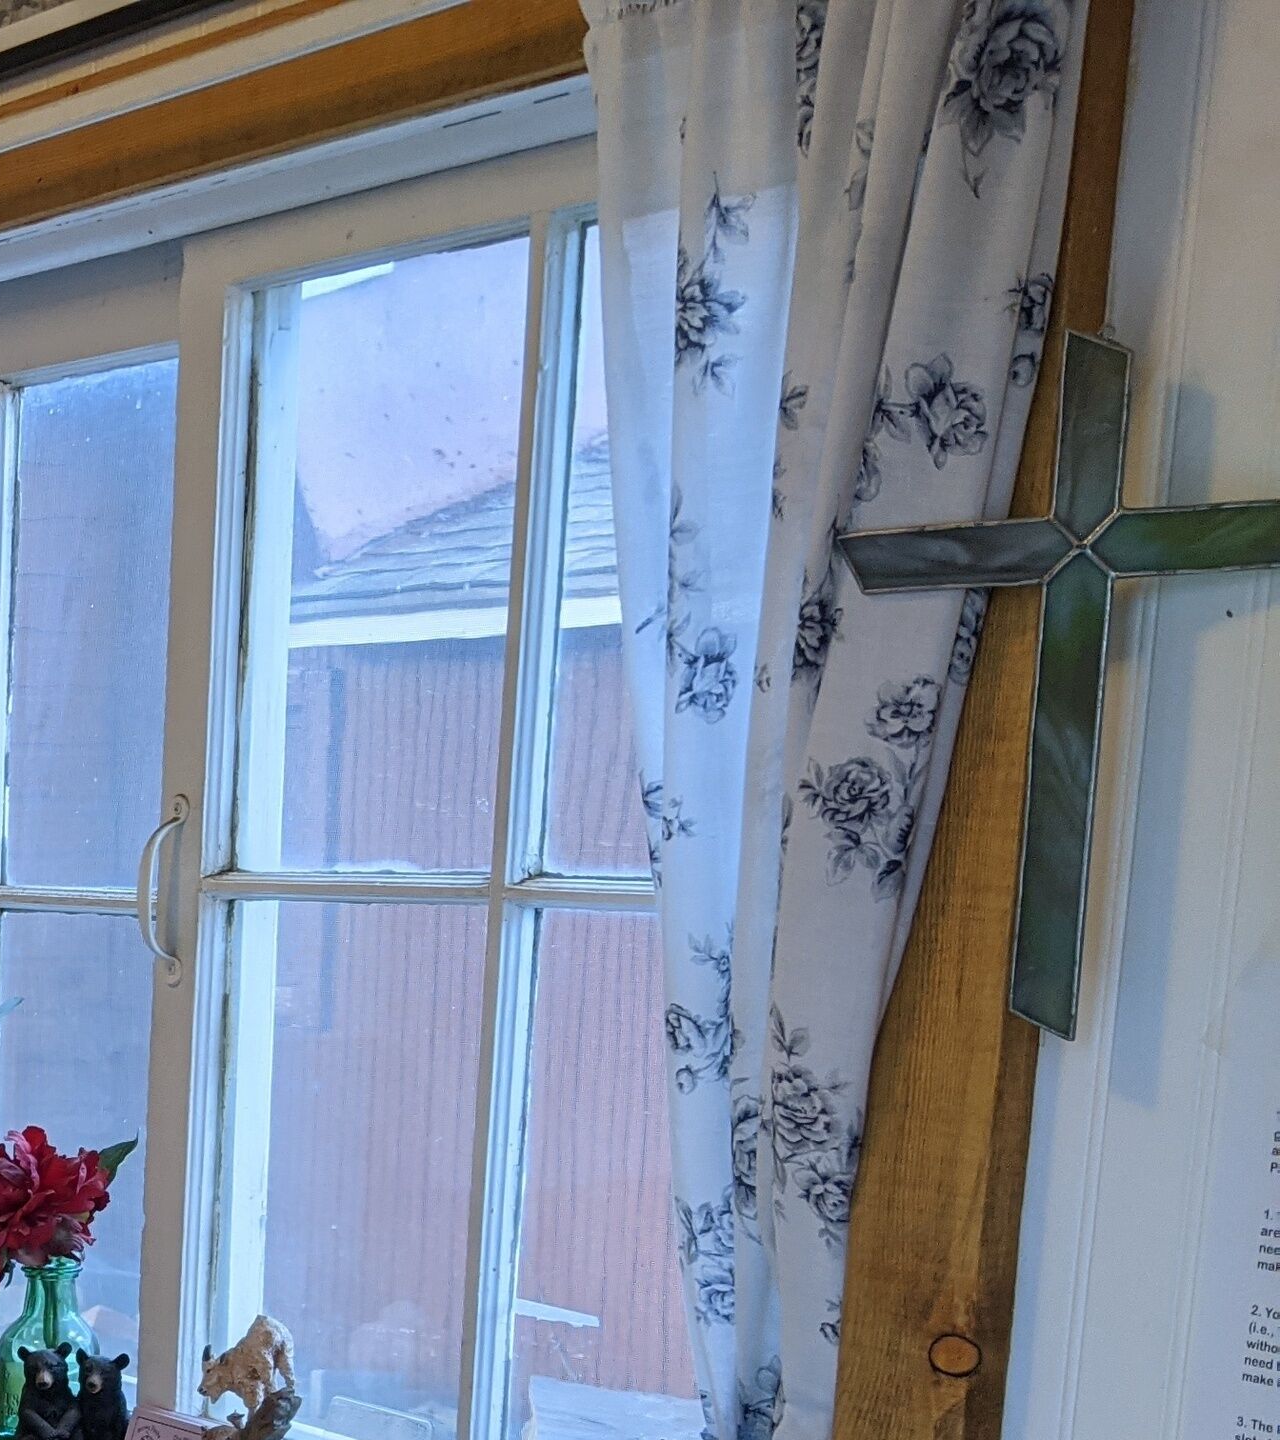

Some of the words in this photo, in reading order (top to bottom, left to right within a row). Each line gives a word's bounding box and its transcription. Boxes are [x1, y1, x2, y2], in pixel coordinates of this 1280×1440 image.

[1244, 1355, 1274, 1372] need
[1241, 1370, 1274, 1388] make
[1250, 1418, 1274, 1434] The
